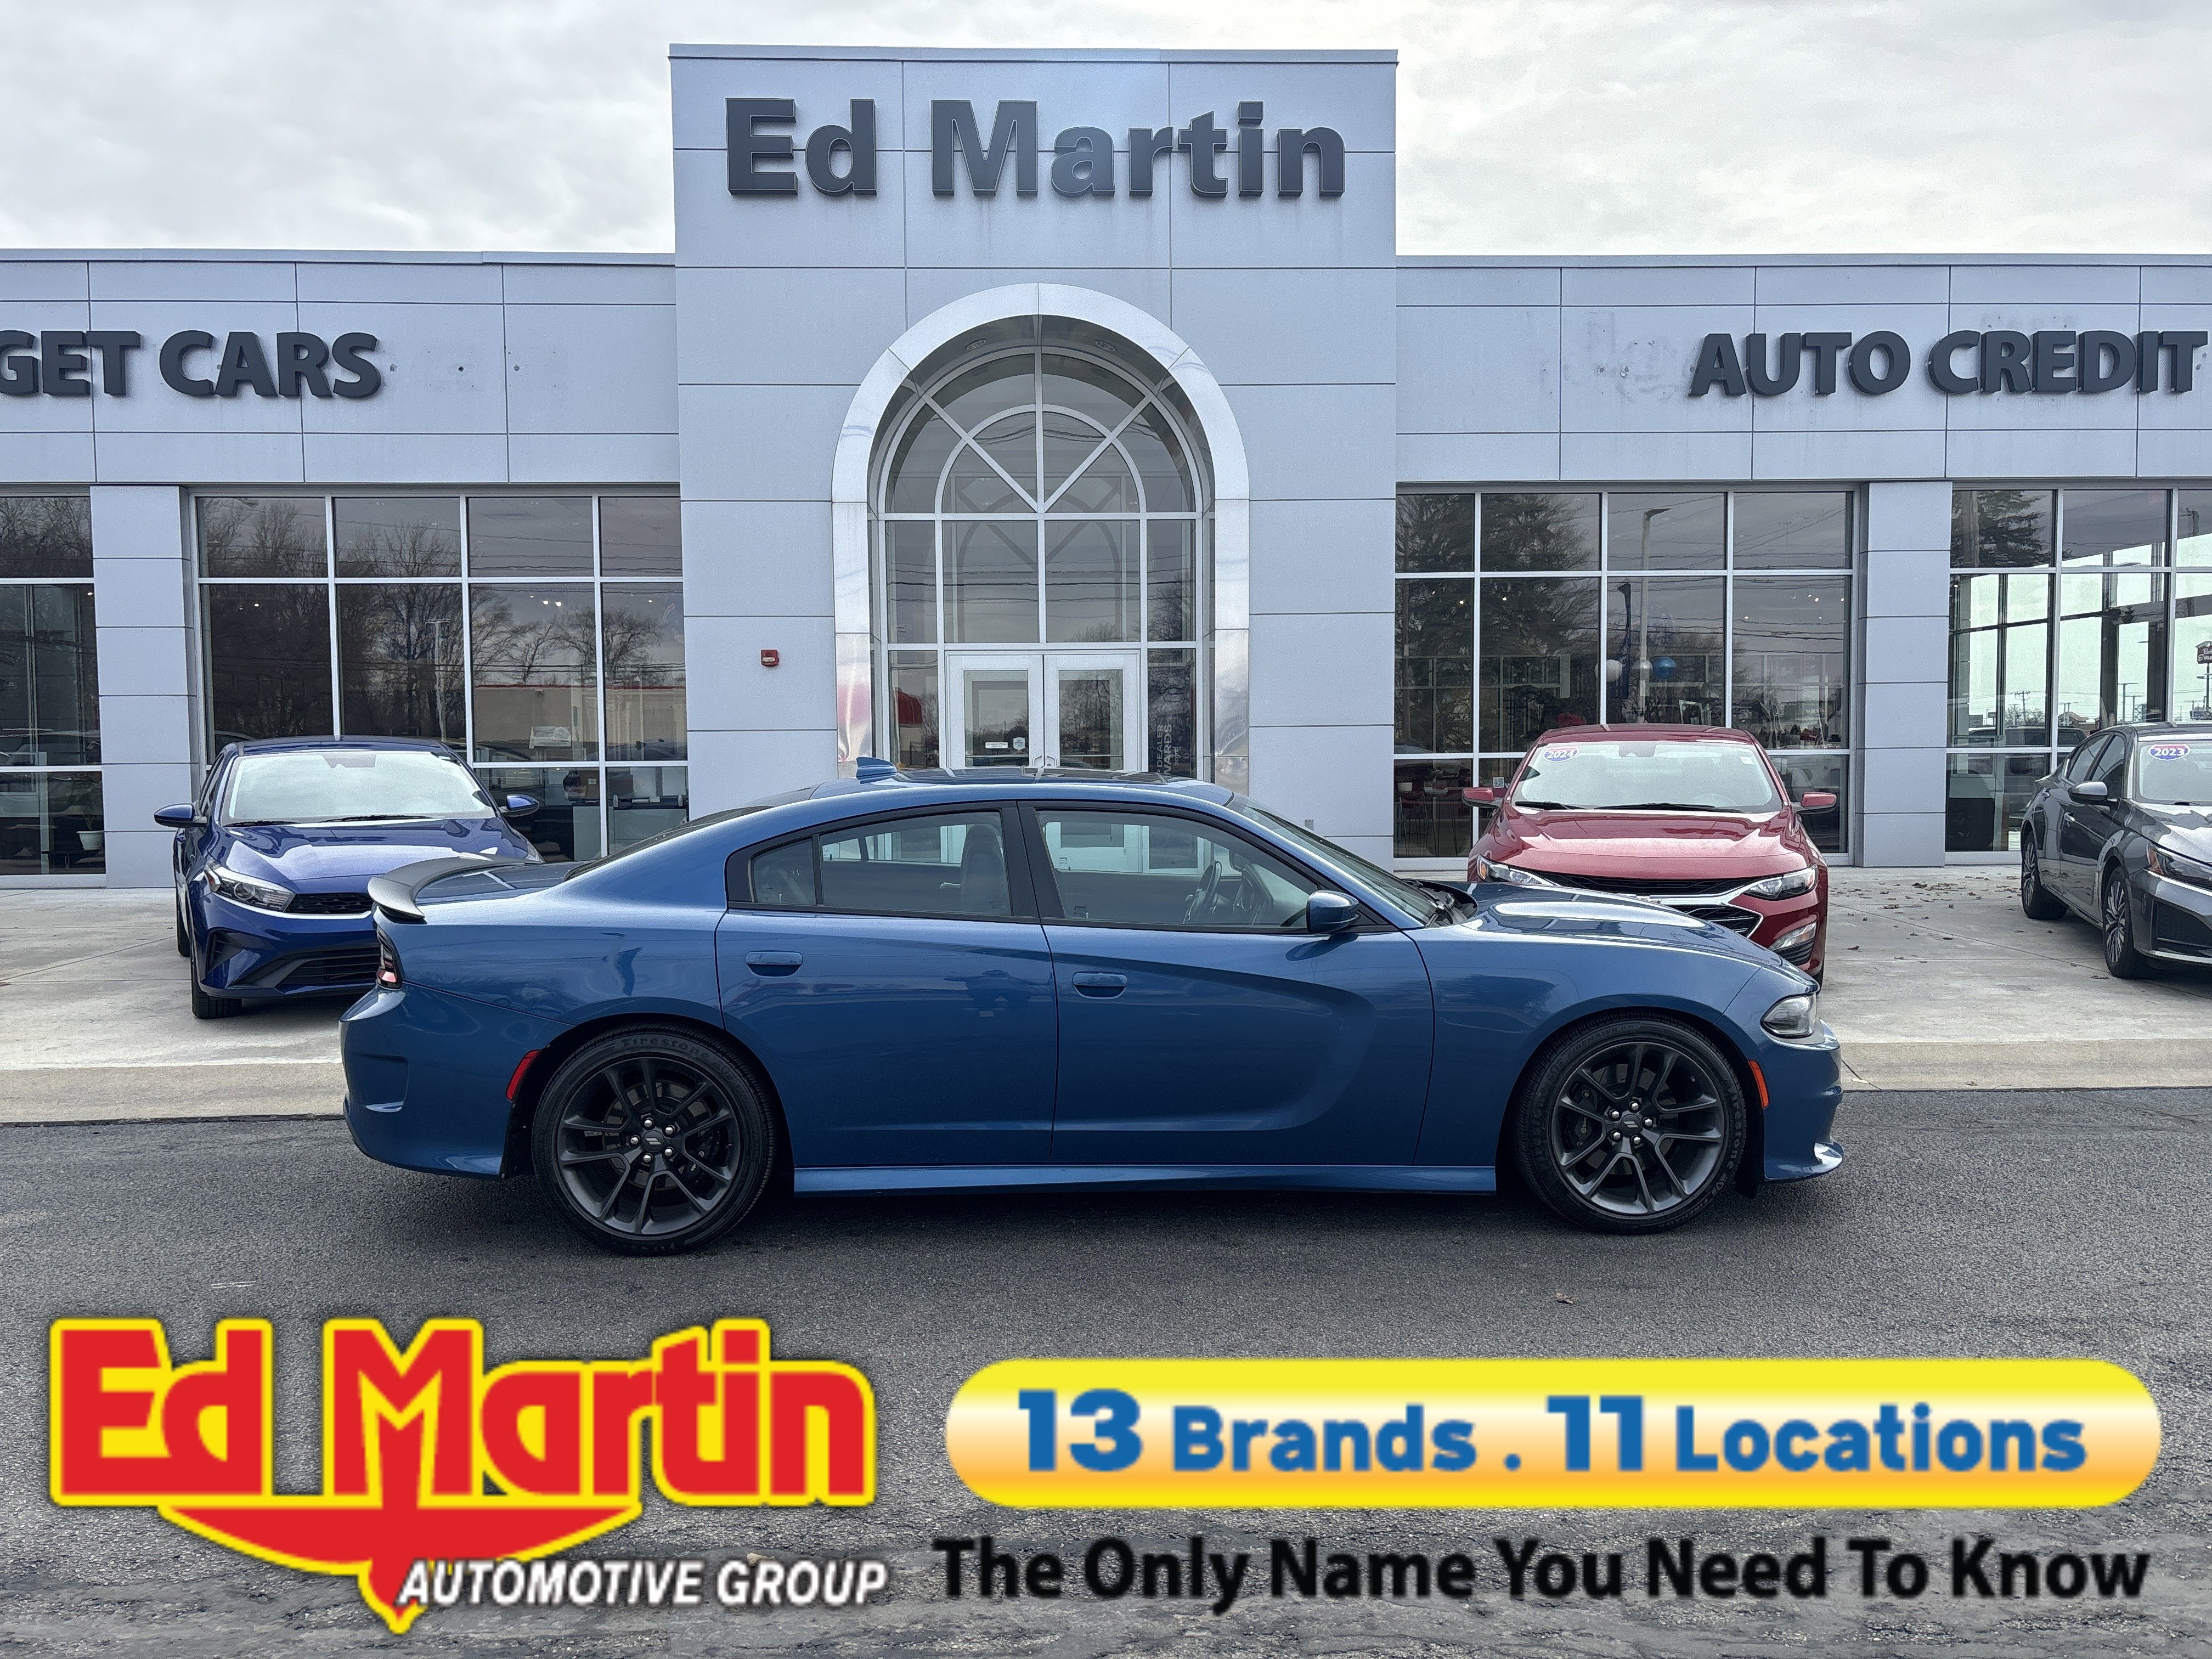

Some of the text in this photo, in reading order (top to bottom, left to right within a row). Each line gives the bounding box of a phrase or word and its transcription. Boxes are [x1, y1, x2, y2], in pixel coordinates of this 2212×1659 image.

[725, 98, 1345, 197] Ed Martin
[160, 330, 381, 398] CARS
[1689, 330, 2208, 396] AUTO CREDIT
[1547, 750, 1575, 759] 2024
[620, 1037, 710, 1061] Firestone
